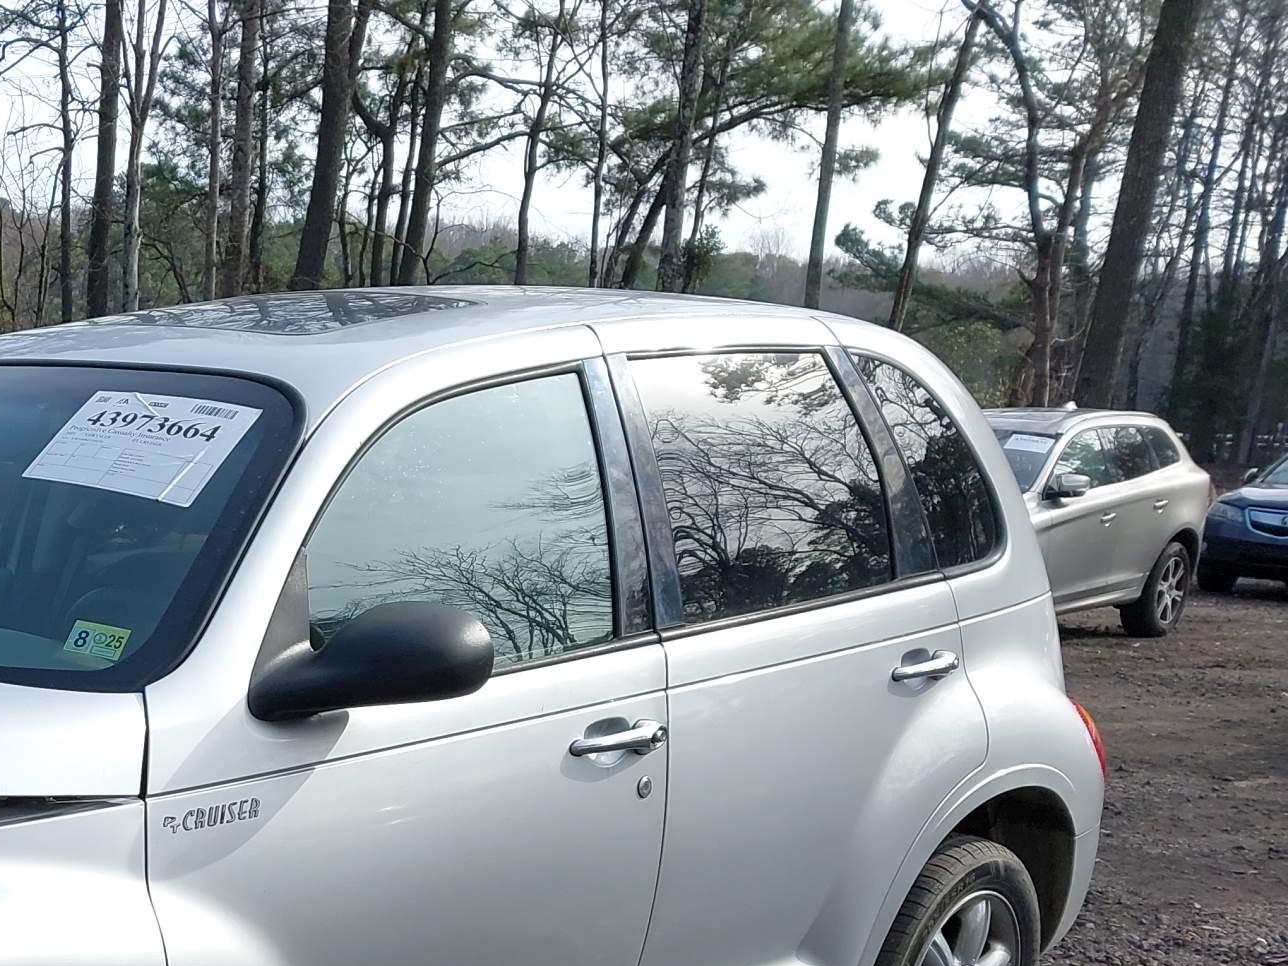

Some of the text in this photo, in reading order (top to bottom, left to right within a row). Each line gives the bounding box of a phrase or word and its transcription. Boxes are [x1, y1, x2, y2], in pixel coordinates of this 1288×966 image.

[87, 410, 222, 442] 43973664
[73, 629, 125, 650] 8 25
[162, 797, 261, 835] PT CRUISER
